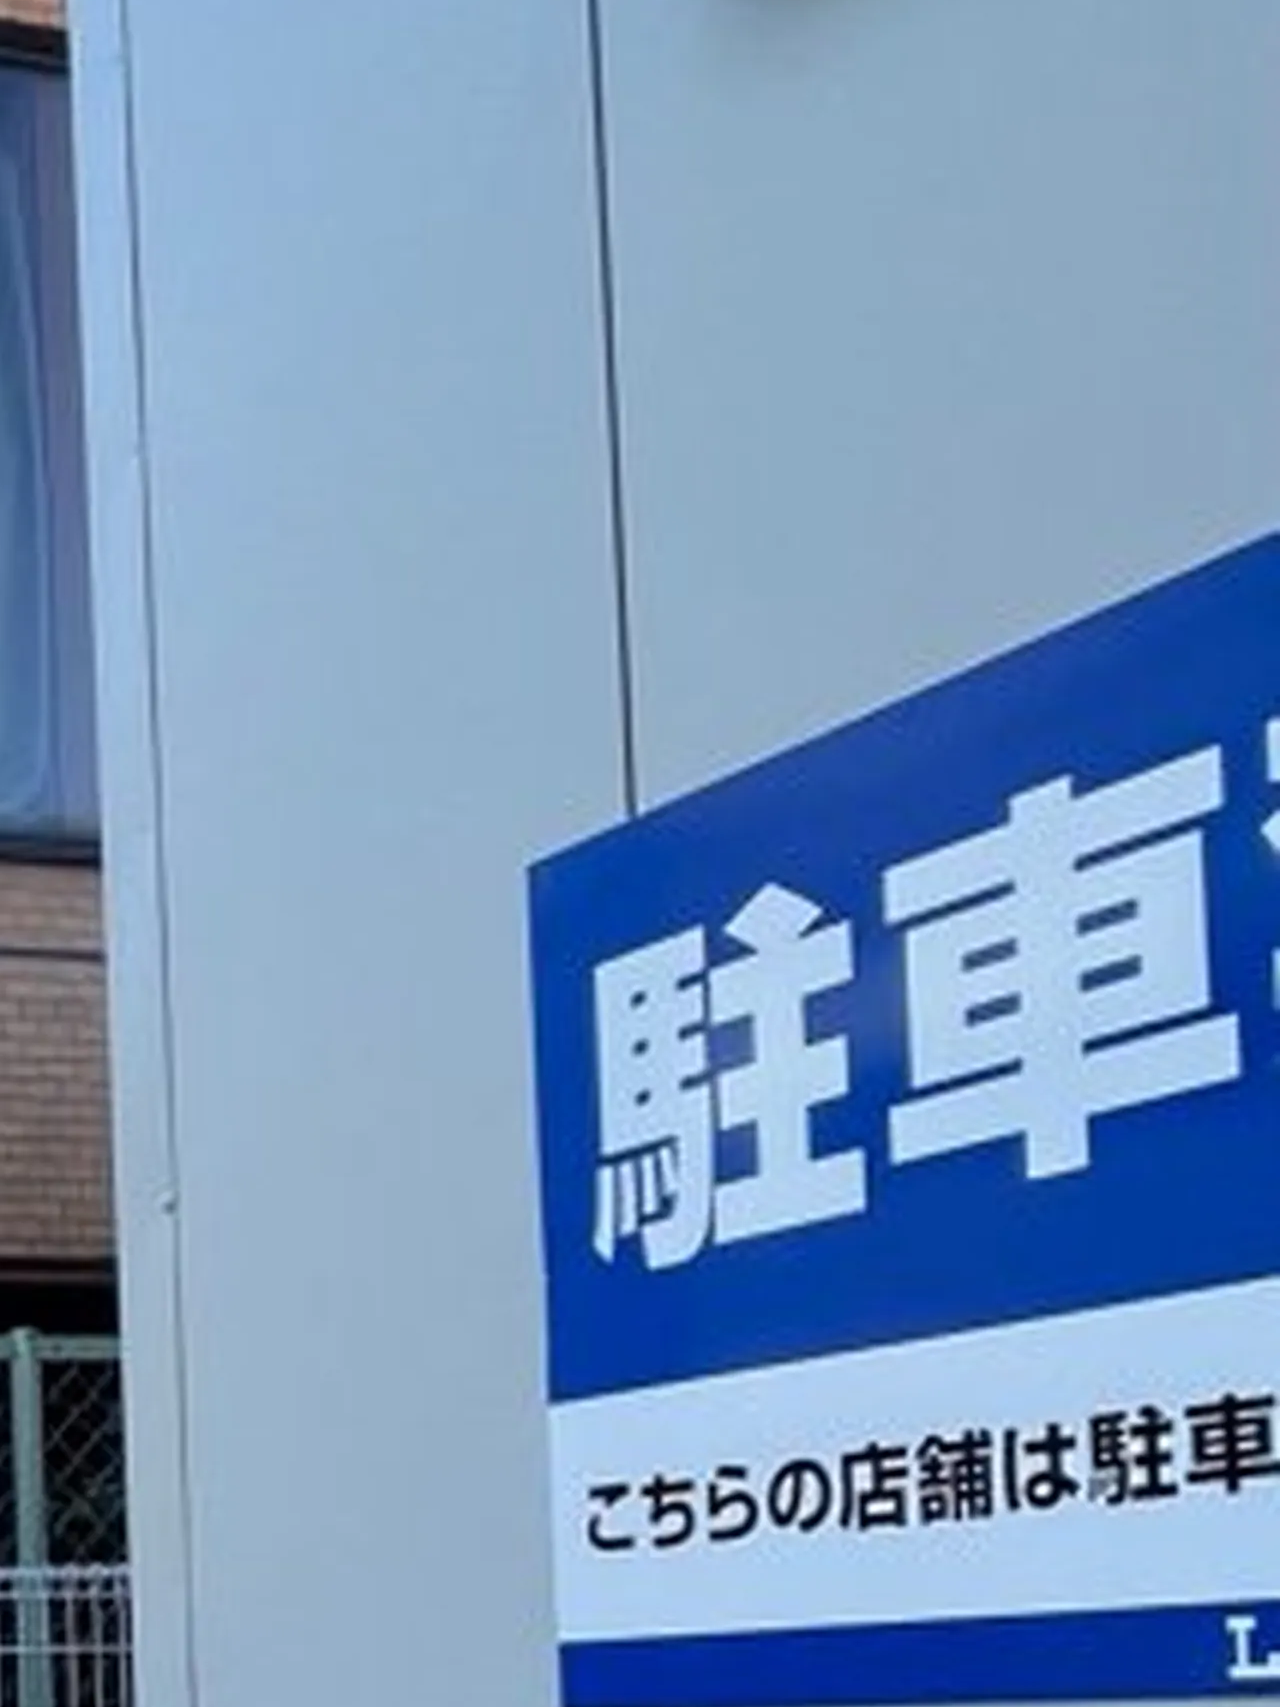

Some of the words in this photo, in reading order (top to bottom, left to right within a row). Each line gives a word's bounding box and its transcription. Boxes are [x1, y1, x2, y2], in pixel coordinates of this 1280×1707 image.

[593, 716, 1280, 1271] 駐車
[585, 1391, 1280, 1552] こちらの店舗は駐車
